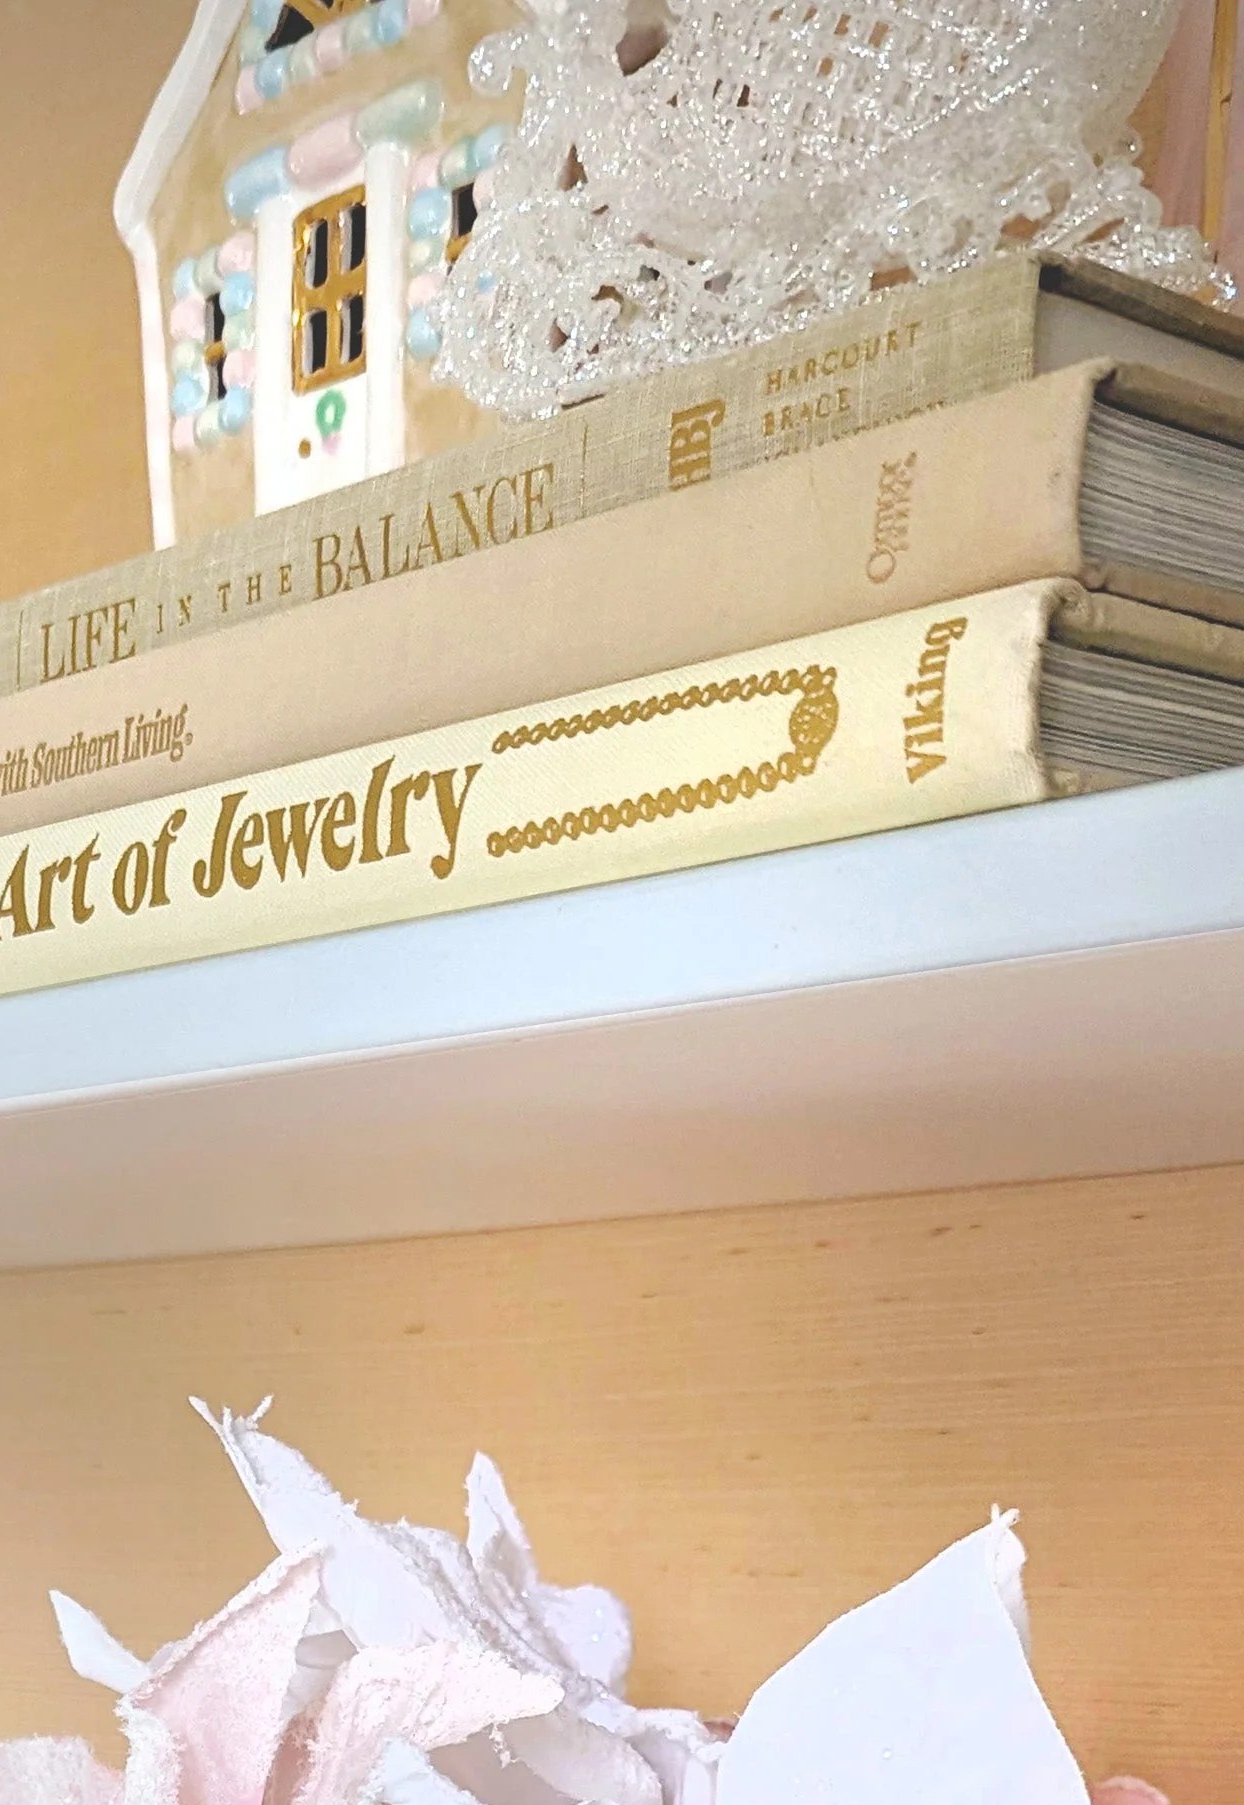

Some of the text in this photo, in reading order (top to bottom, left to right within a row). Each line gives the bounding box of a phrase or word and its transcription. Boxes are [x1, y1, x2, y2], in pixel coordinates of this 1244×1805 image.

[763, 387, 852, 437] BRACE
[764, 321, 923, 395] HARCOURT
[40, 597, 137, 684] LIFE
[156, 595, 192, 635] IN
[217, 564, 293, 613] THE
[312, 462, 555, 601] BALANCE
[31, 729, 119, 789] Southern
[902, 616, 969, 785] Viking
[110, 807, 189, 916] of
[192, 753, 483, 899] Jewelry
